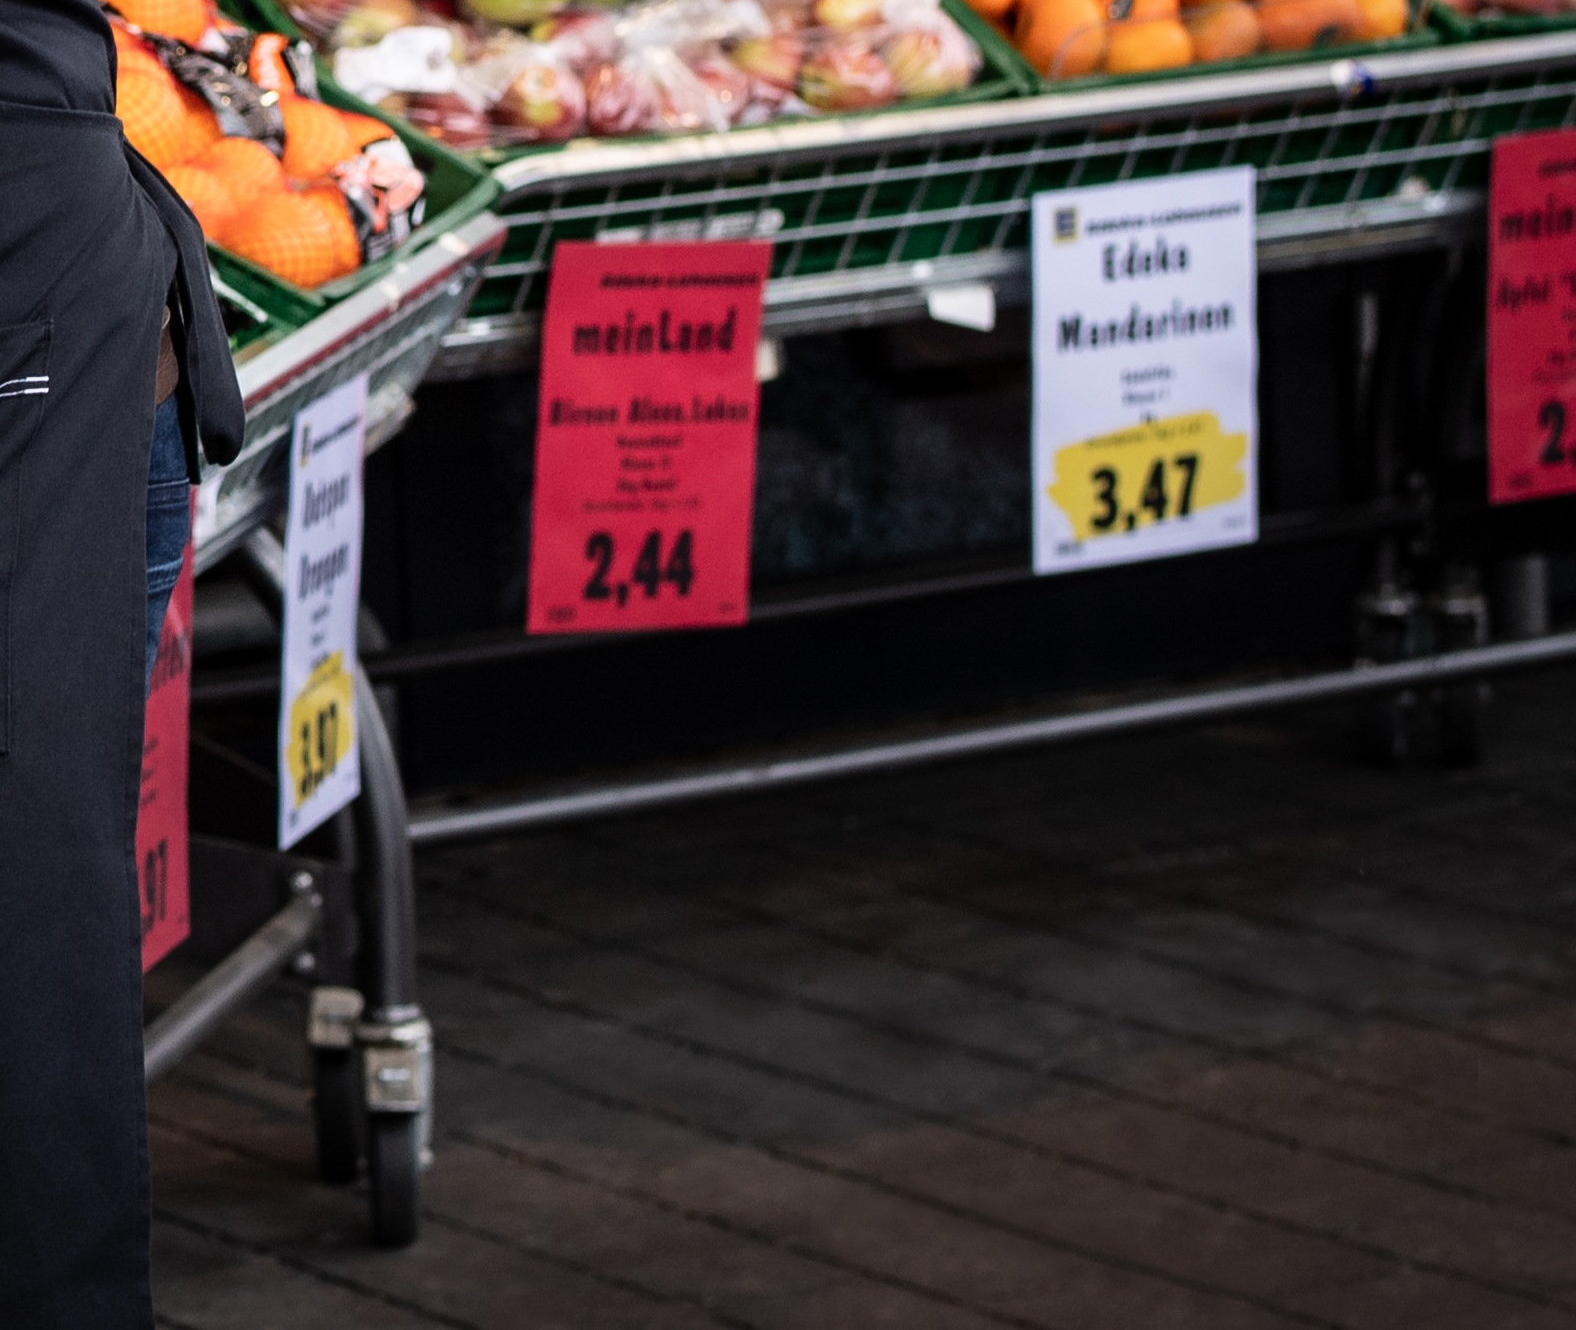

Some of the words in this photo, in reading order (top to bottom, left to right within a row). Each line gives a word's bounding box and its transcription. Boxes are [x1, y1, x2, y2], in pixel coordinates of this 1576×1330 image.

[1499, 196, 1576, 243] mein
[1103, 236, 1190, 283] Edeka
[1058, 300, 1233, 352] Mandarinen
[1090, 451, 1201, 533] 3,47
[583, 528, 694, 610] 2,44
